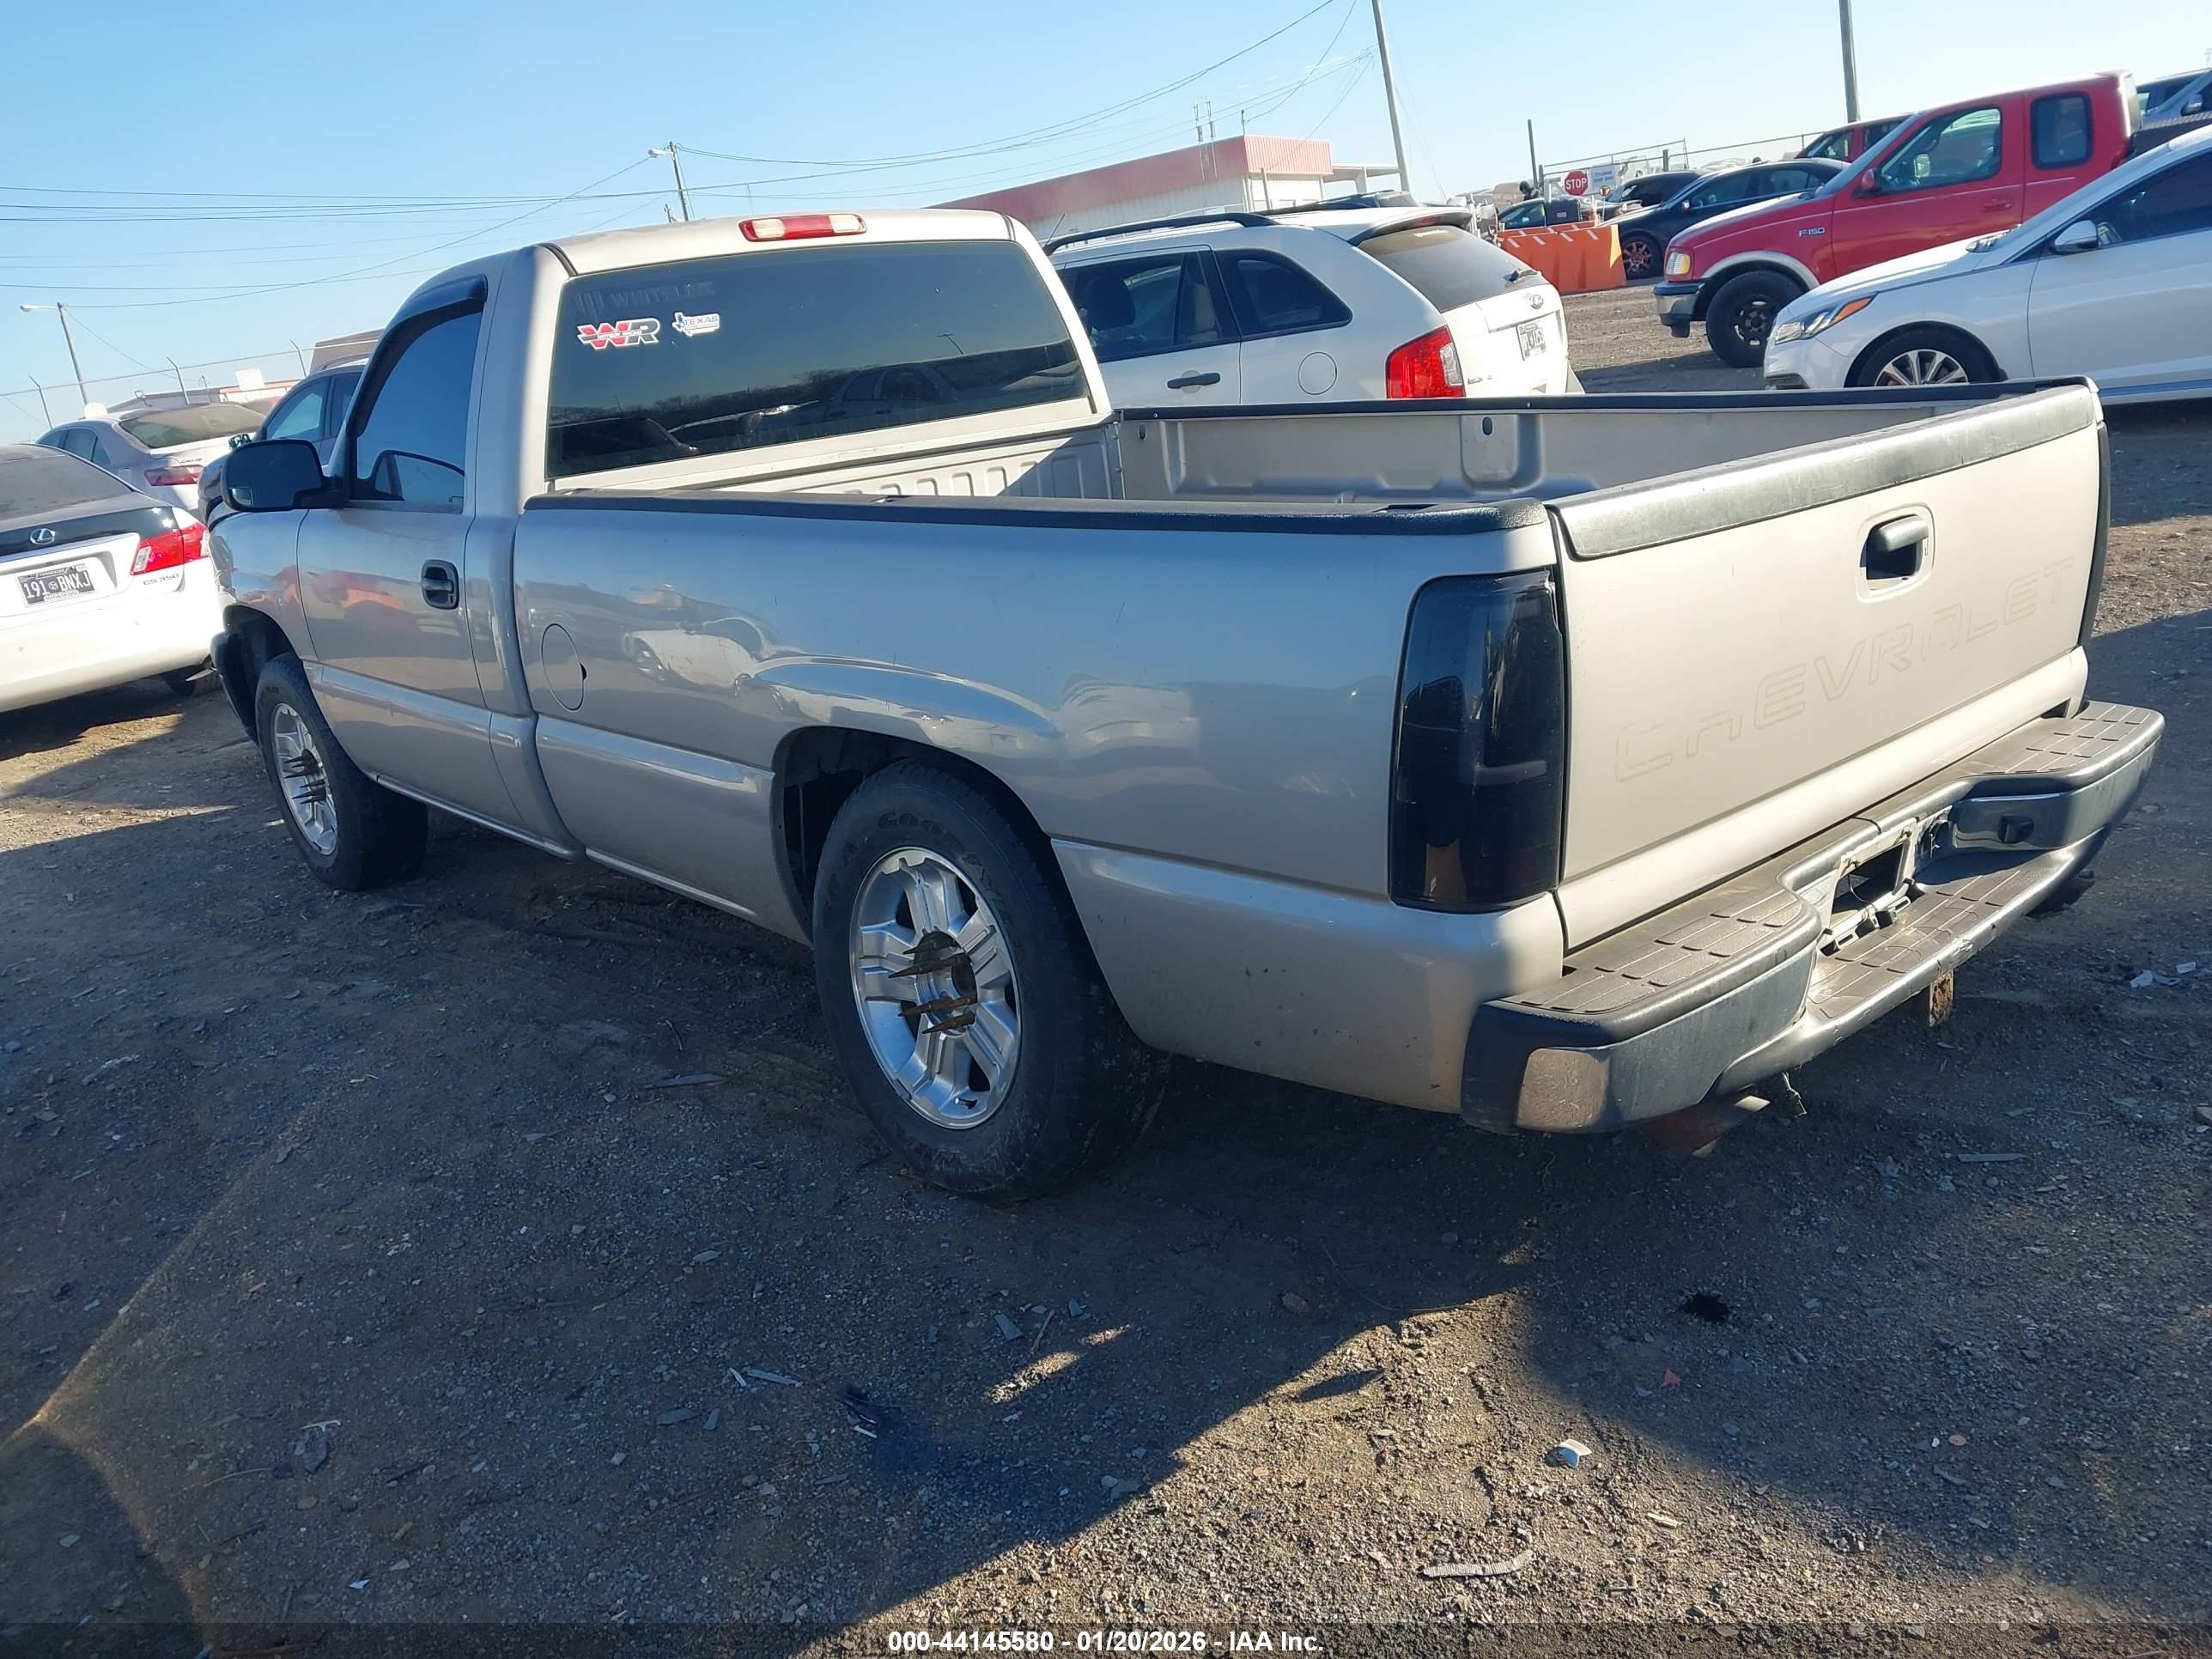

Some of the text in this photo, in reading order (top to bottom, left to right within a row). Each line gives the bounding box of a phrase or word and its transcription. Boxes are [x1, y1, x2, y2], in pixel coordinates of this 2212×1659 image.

[1565, 177, 1587, 190] STOP
[684, 315, 719, 326] TEXAS
[23, 580, 51, 599] 191
[55, 571, 91, 592] BNXJ
[1613, 556, 2076, 783] CHEVROLET
